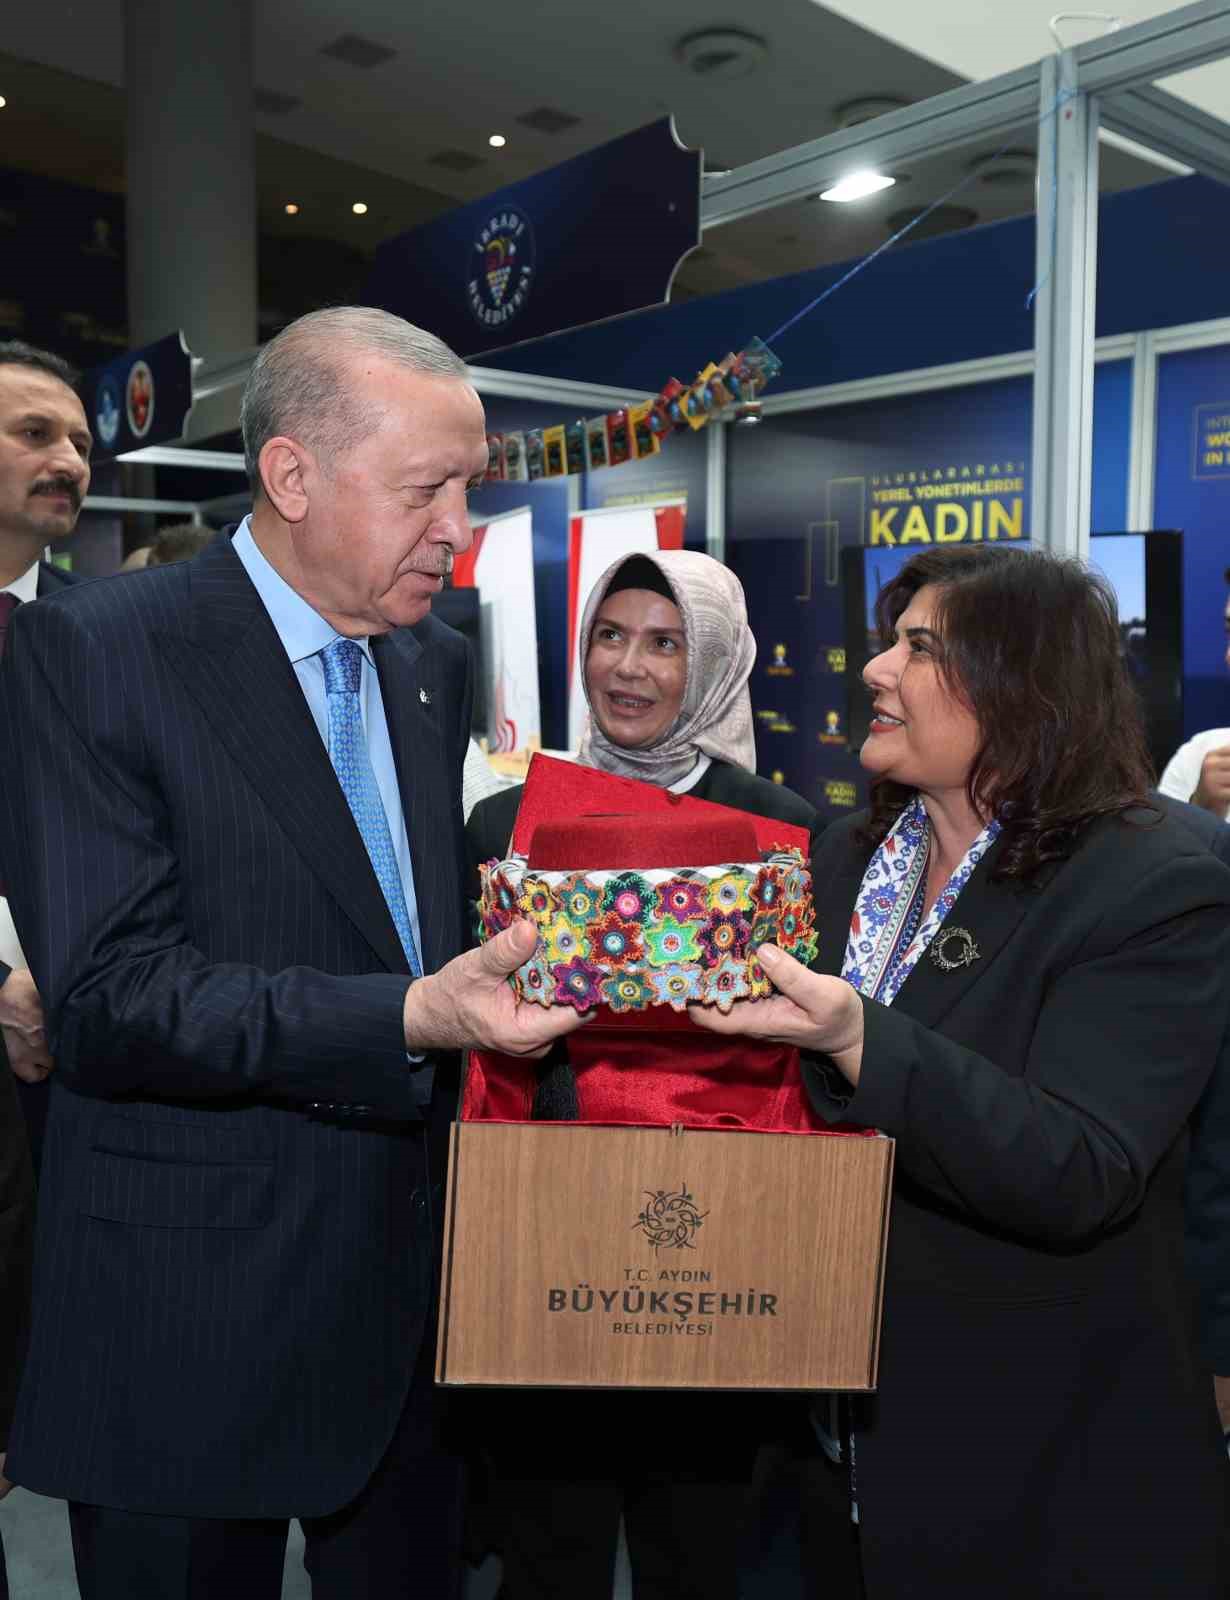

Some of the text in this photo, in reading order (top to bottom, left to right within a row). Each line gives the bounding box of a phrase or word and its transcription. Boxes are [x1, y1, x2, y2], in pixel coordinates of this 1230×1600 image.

[870, 498, 1023, 544] KADIN
[659, 1270, 711, 1283] AYDIN
[548, 1283, 778, 1321] BÜYÜKŞEHİR
[613, 1321, 713, 1335] BELEDİYESİ
